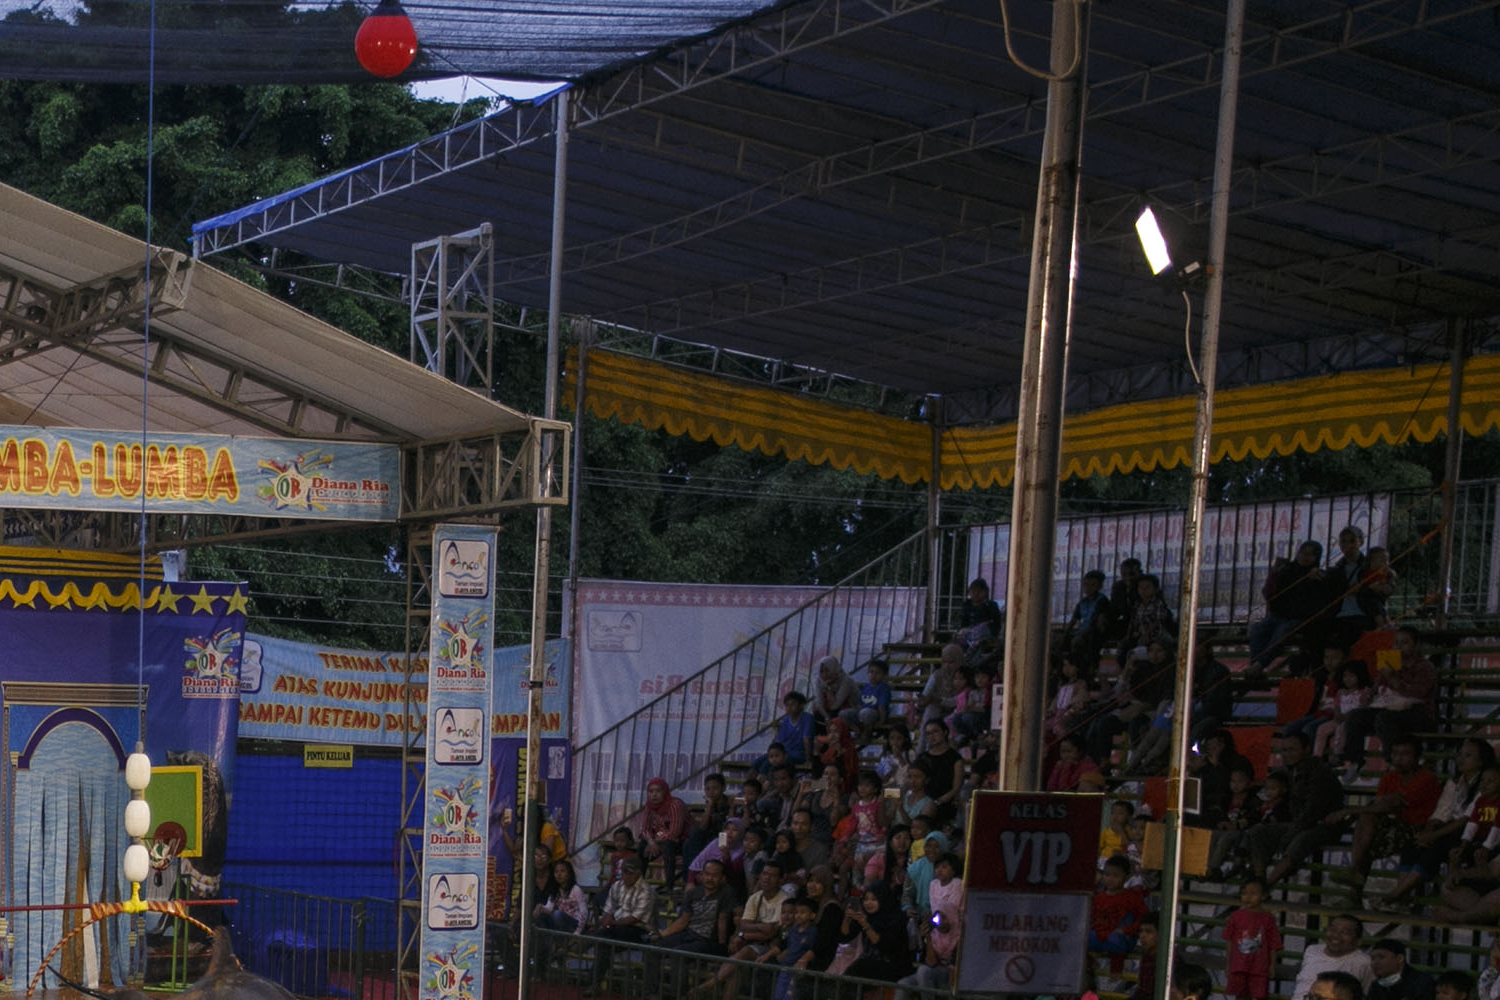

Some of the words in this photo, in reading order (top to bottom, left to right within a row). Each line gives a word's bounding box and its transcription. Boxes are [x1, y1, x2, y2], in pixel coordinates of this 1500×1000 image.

[311, 477, 357, 490] Diana
[362, 480, 389, 491] Ria
[318, 653, 388, 673] TERIMA
[437, 667, 467, 678] Diana
[470, 667, 486, 678] Ria
[184, 677, 217, 687] Diana
[274, 676, 318, 695] ATAS
[324, 681, 428, 702] KUNJUNGA
[308, 707, 381, 731] KETEMU
[306, 751, 325, 761] PINTU
[326, 751, 351, 761] KELUAR
[1009, 803, 1068, 819] KELAS
[430, 834, 461, 844] Diana
[464, 833, 481, 844] Ria
[1001, 831, 1073, 885] VIP
[983, 914, 1069, 932] DILARANG
[988, 936, 1061, 953] MEROKOK
